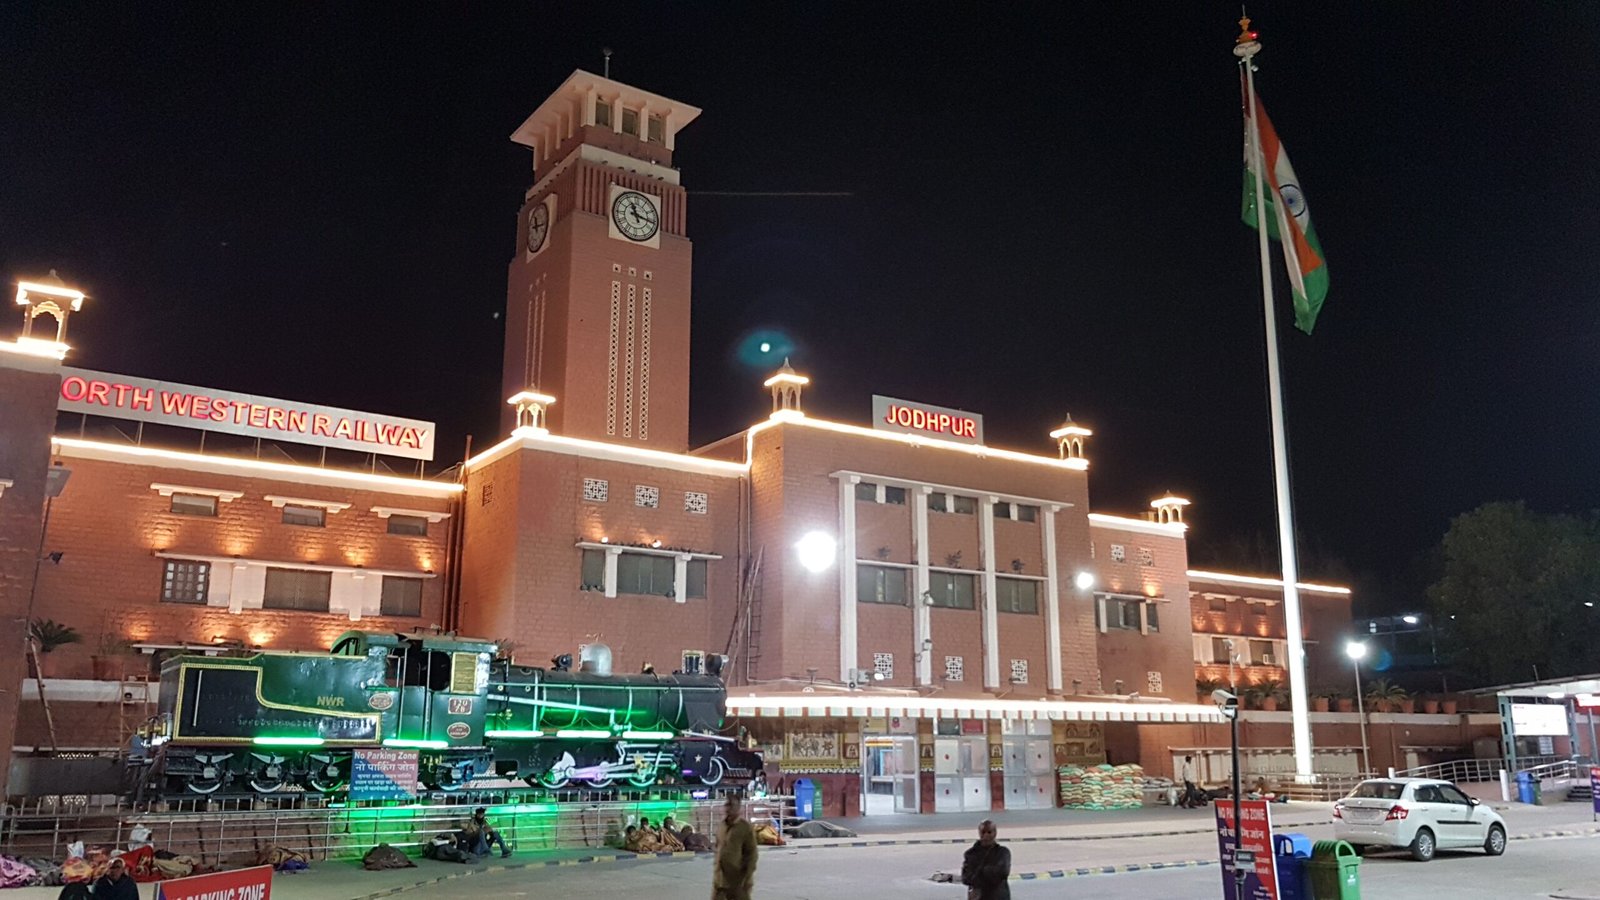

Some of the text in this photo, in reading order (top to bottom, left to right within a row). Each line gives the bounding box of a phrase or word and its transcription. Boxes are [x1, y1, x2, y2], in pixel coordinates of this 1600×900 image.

[61, 376, 428, 449] ORTH WESTERN RAILWAY
[885, 405, 976, 437] JODHPUR
[317, 696, 344, 706] NWR
[367, 752, 396, 761] Parking
[187, 889, 235, 900] KING
